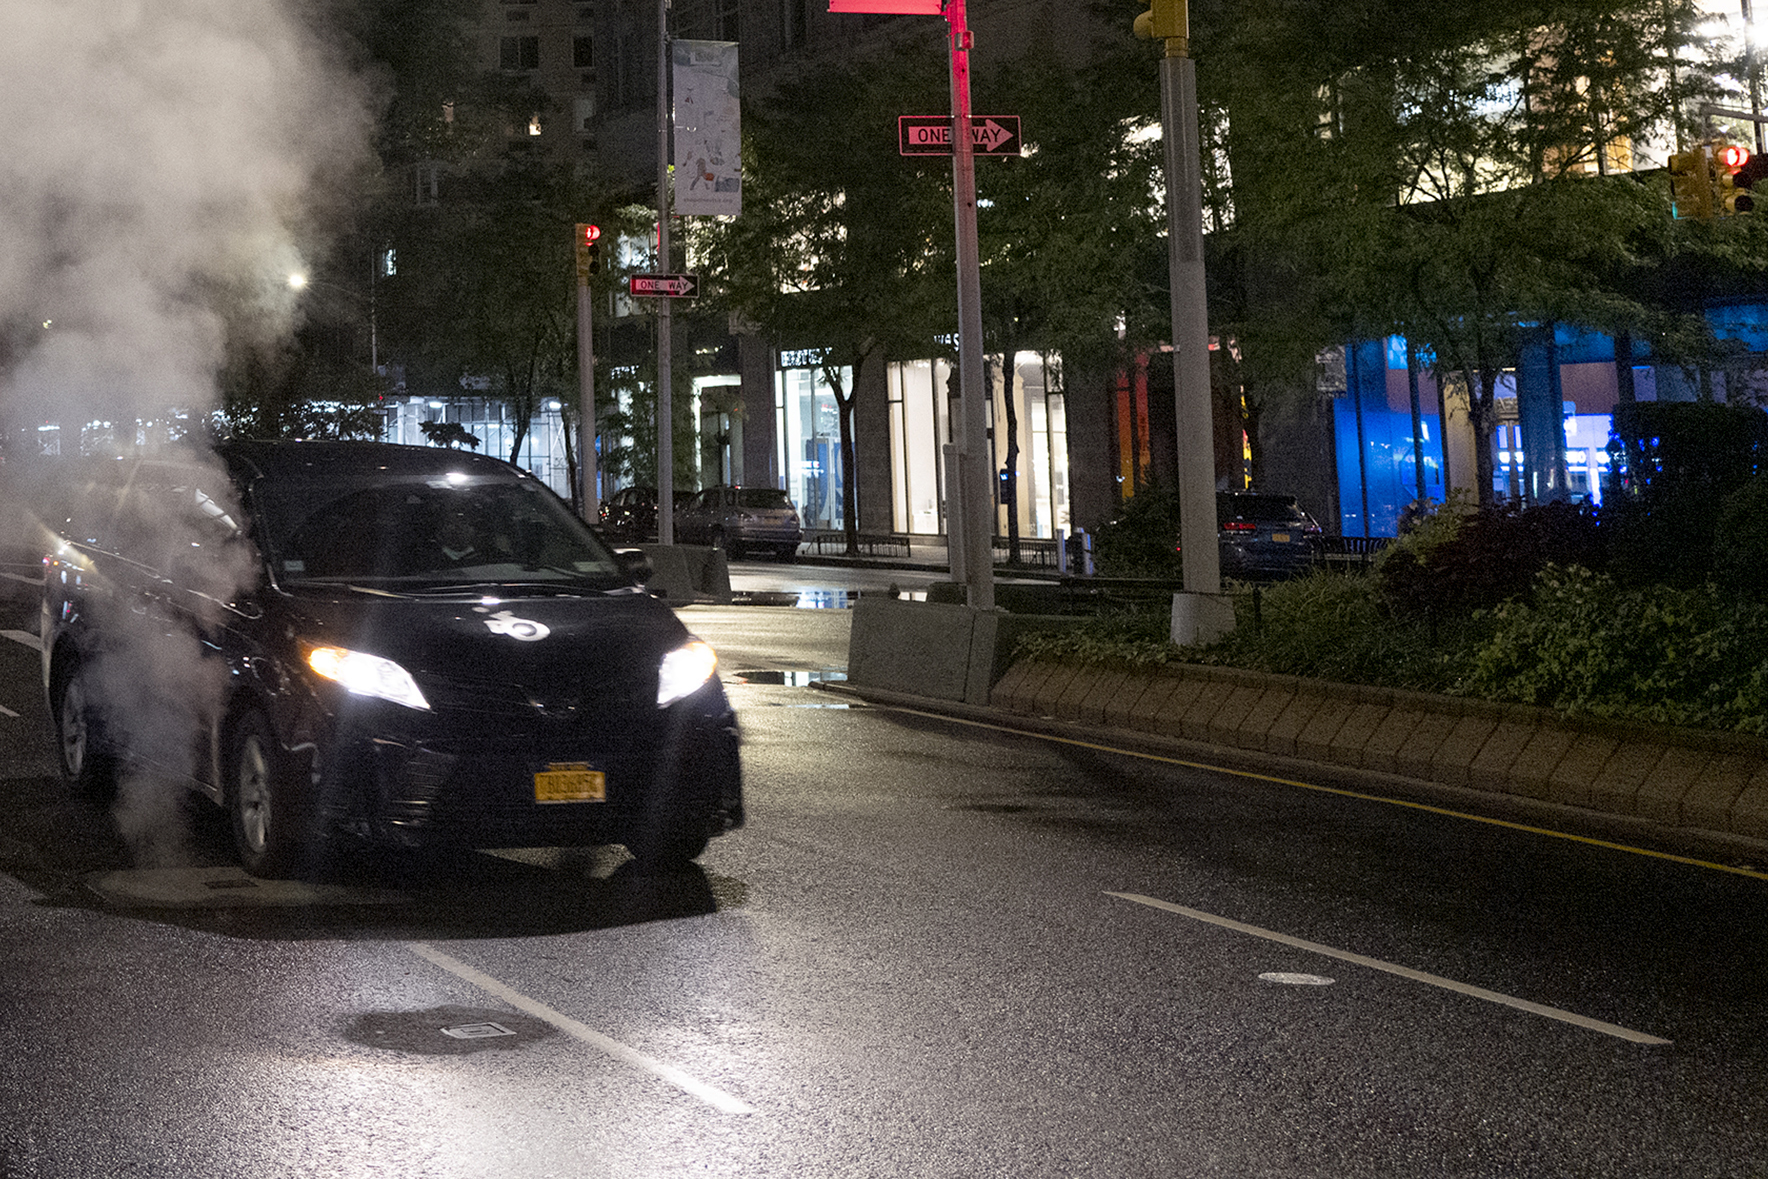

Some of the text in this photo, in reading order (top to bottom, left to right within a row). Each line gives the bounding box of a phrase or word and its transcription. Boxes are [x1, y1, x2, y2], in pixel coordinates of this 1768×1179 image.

[918, 128, 952, 143] ONE
[640, 281, 689, 290] ONE WAY
